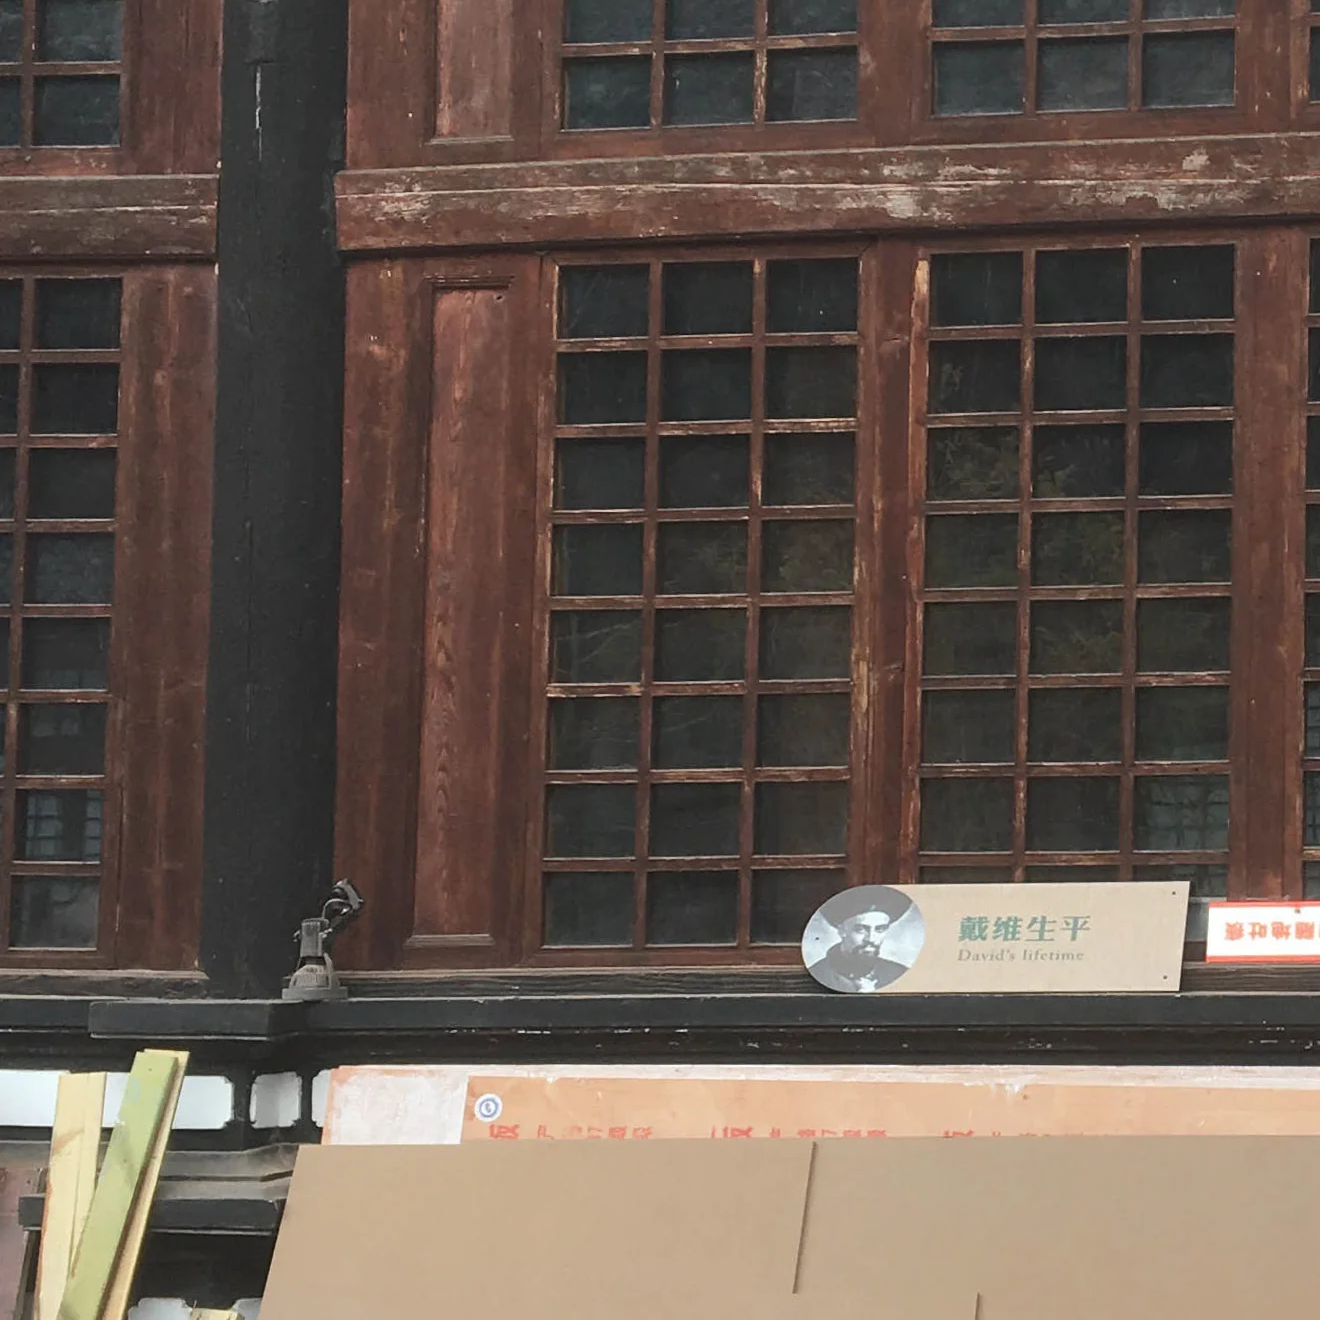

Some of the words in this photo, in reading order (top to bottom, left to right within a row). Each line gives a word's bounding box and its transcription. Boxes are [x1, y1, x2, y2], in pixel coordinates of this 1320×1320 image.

[958, 914, 1091, 942] 戴维生平
[957, 948, 1017, 962] David's
[1023, 948, 1085, 962] lifetime
